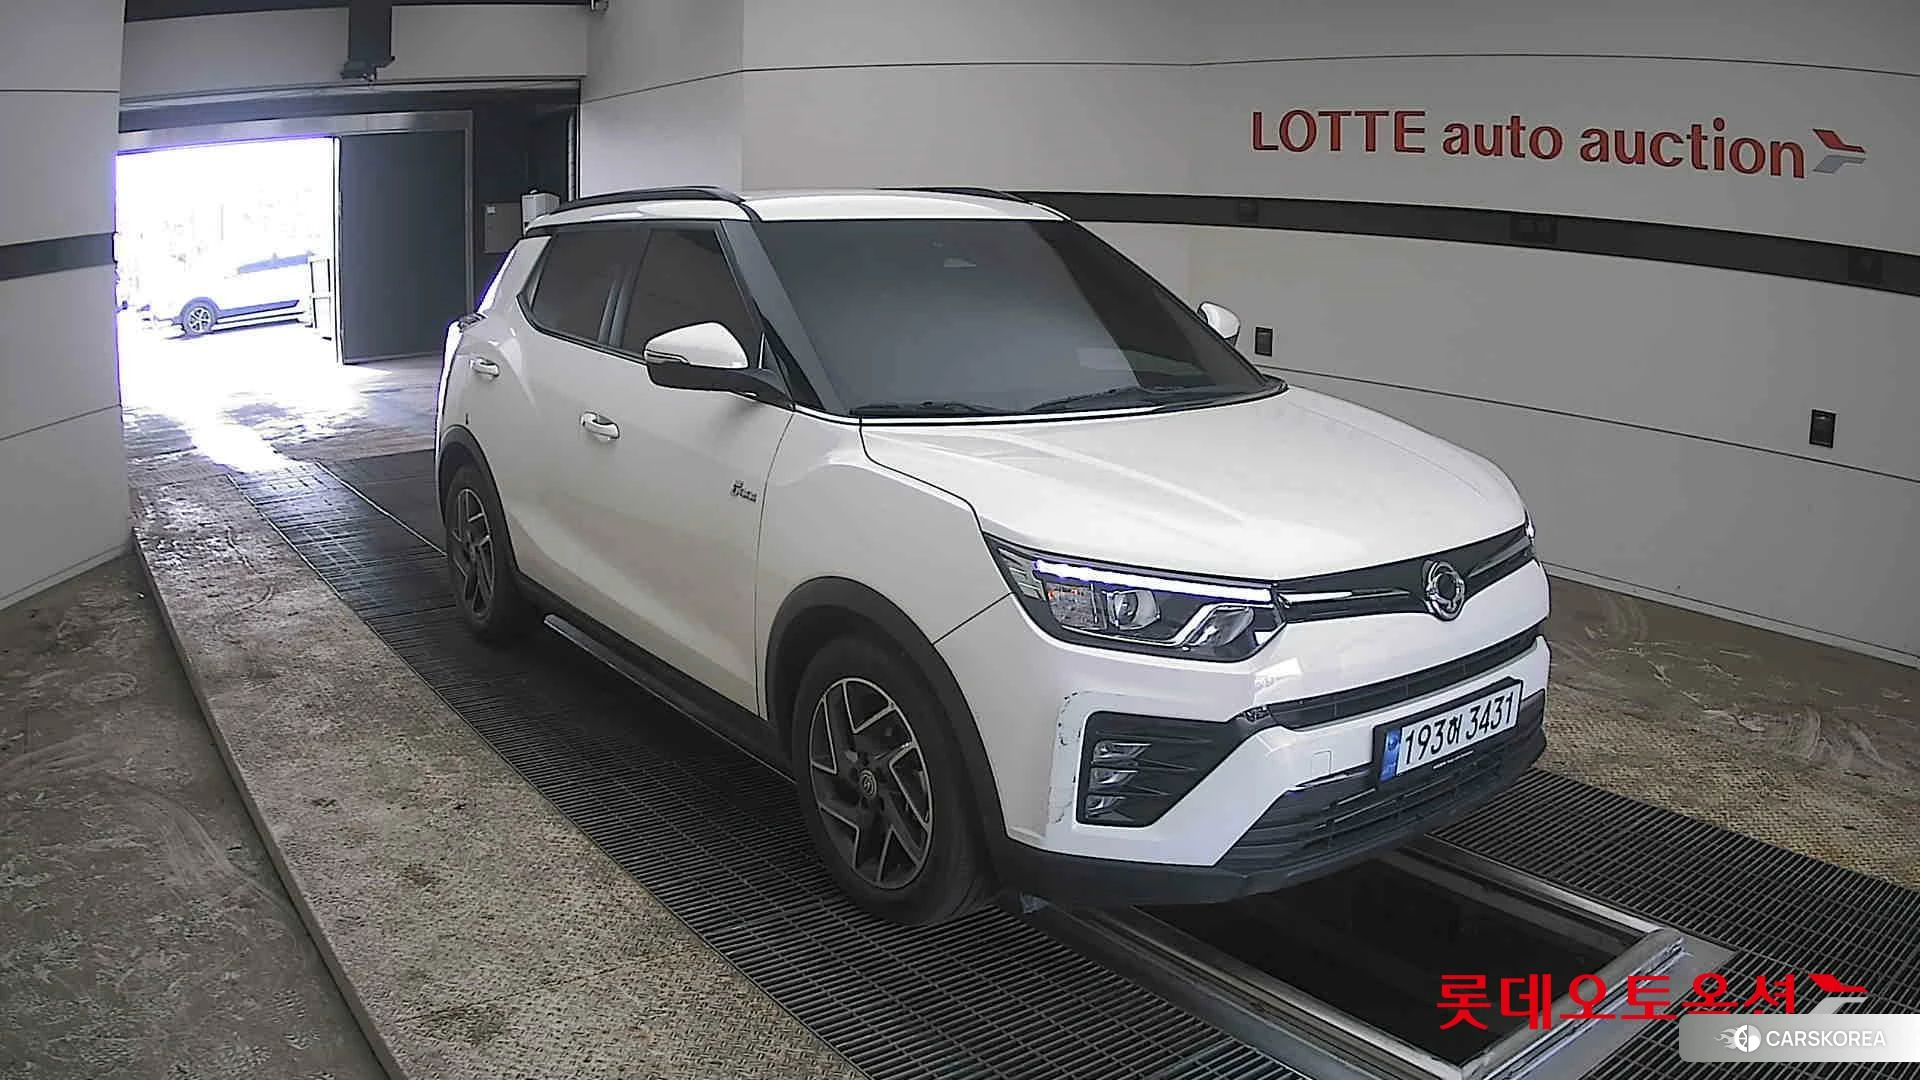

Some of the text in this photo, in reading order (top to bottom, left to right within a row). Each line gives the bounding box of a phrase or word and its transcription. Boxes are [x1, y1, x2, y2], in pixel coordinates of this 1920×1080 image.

[1252, 110, 1805, 178] LOTTE auto auction
[1466, 691, 1514, 740] 3431
